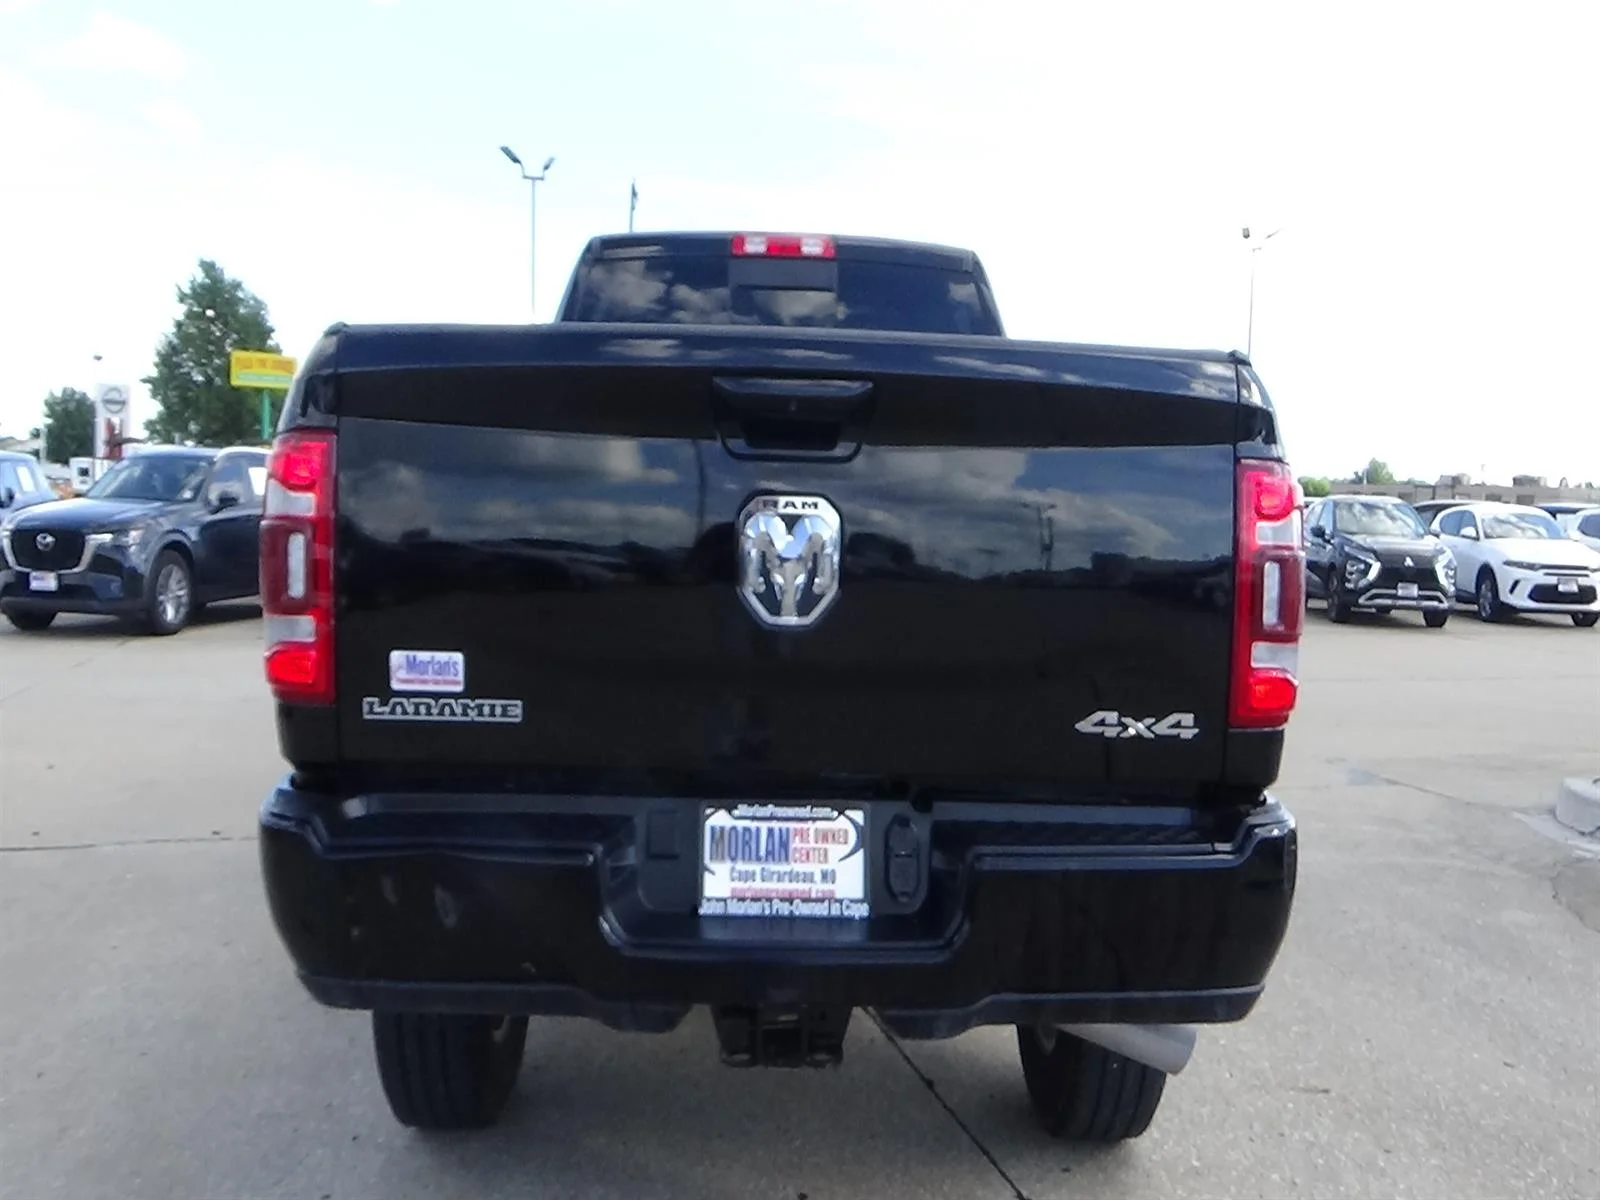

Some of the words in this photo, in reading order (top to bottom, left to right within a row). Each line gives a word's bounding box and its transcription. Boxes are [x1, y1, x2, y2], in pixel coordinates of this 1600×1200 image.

[762, 499, 818, 510] RAM
[406, 654, 458, 676] Morlan's
[363, 697, 522, 722] LARAMIE
[1074, 710, 1200, 739] 4x4
[710, 826, 789, 862] MORLAN
[793, 827, 810, 844] PRE
[814, 828, 848, 845] OWNED
[793, 847, 828, 863] CENTER
[730, 867, 756, 883] Cape
[760, 868, 817, 884] Girardeau,
[821, 869, 836, 884] MO
[843, 899, 869, 918] Cape
